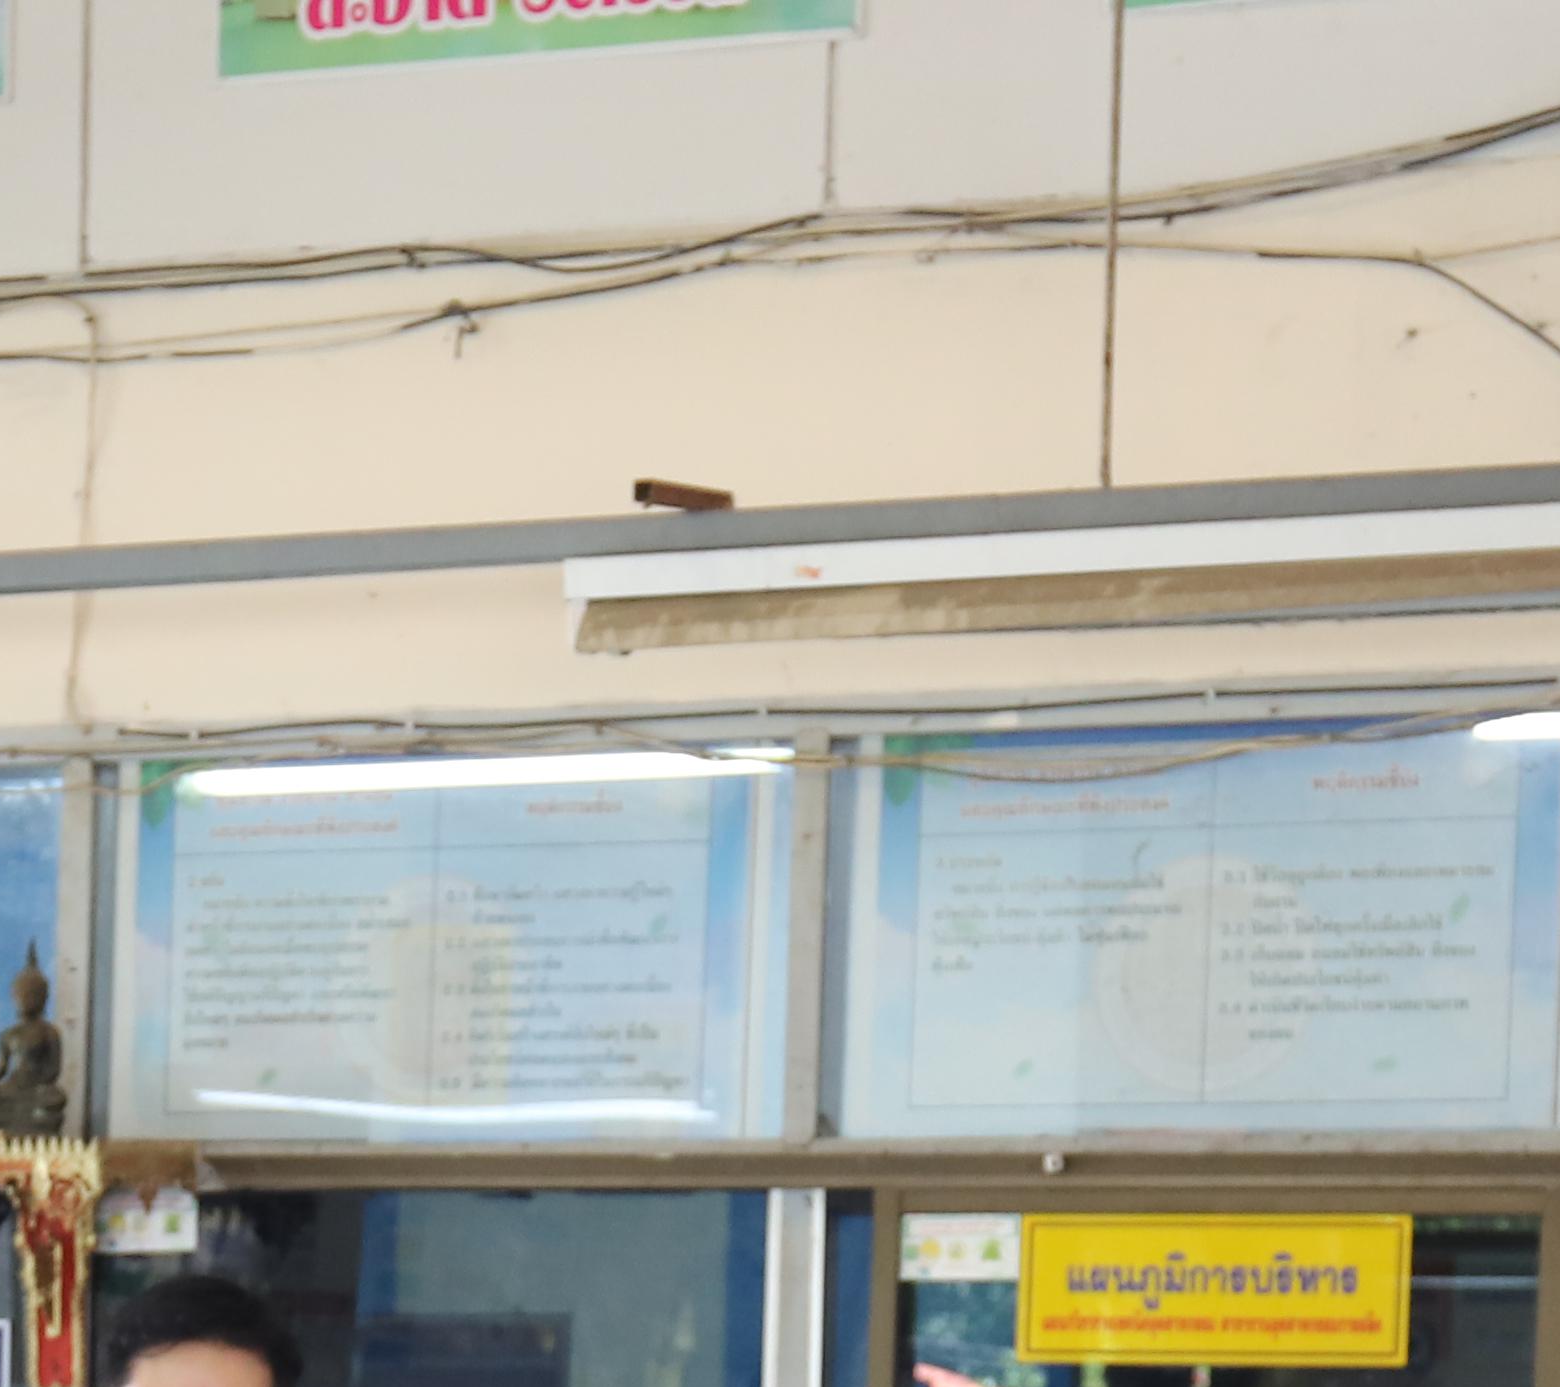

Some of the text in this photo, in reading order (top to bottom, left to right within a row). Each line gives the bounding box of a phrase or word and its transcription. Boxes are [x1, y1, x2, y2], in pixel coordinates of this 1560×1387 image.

[1066, 1252, 1358, 1310] แผนภูมิการบริหาร
